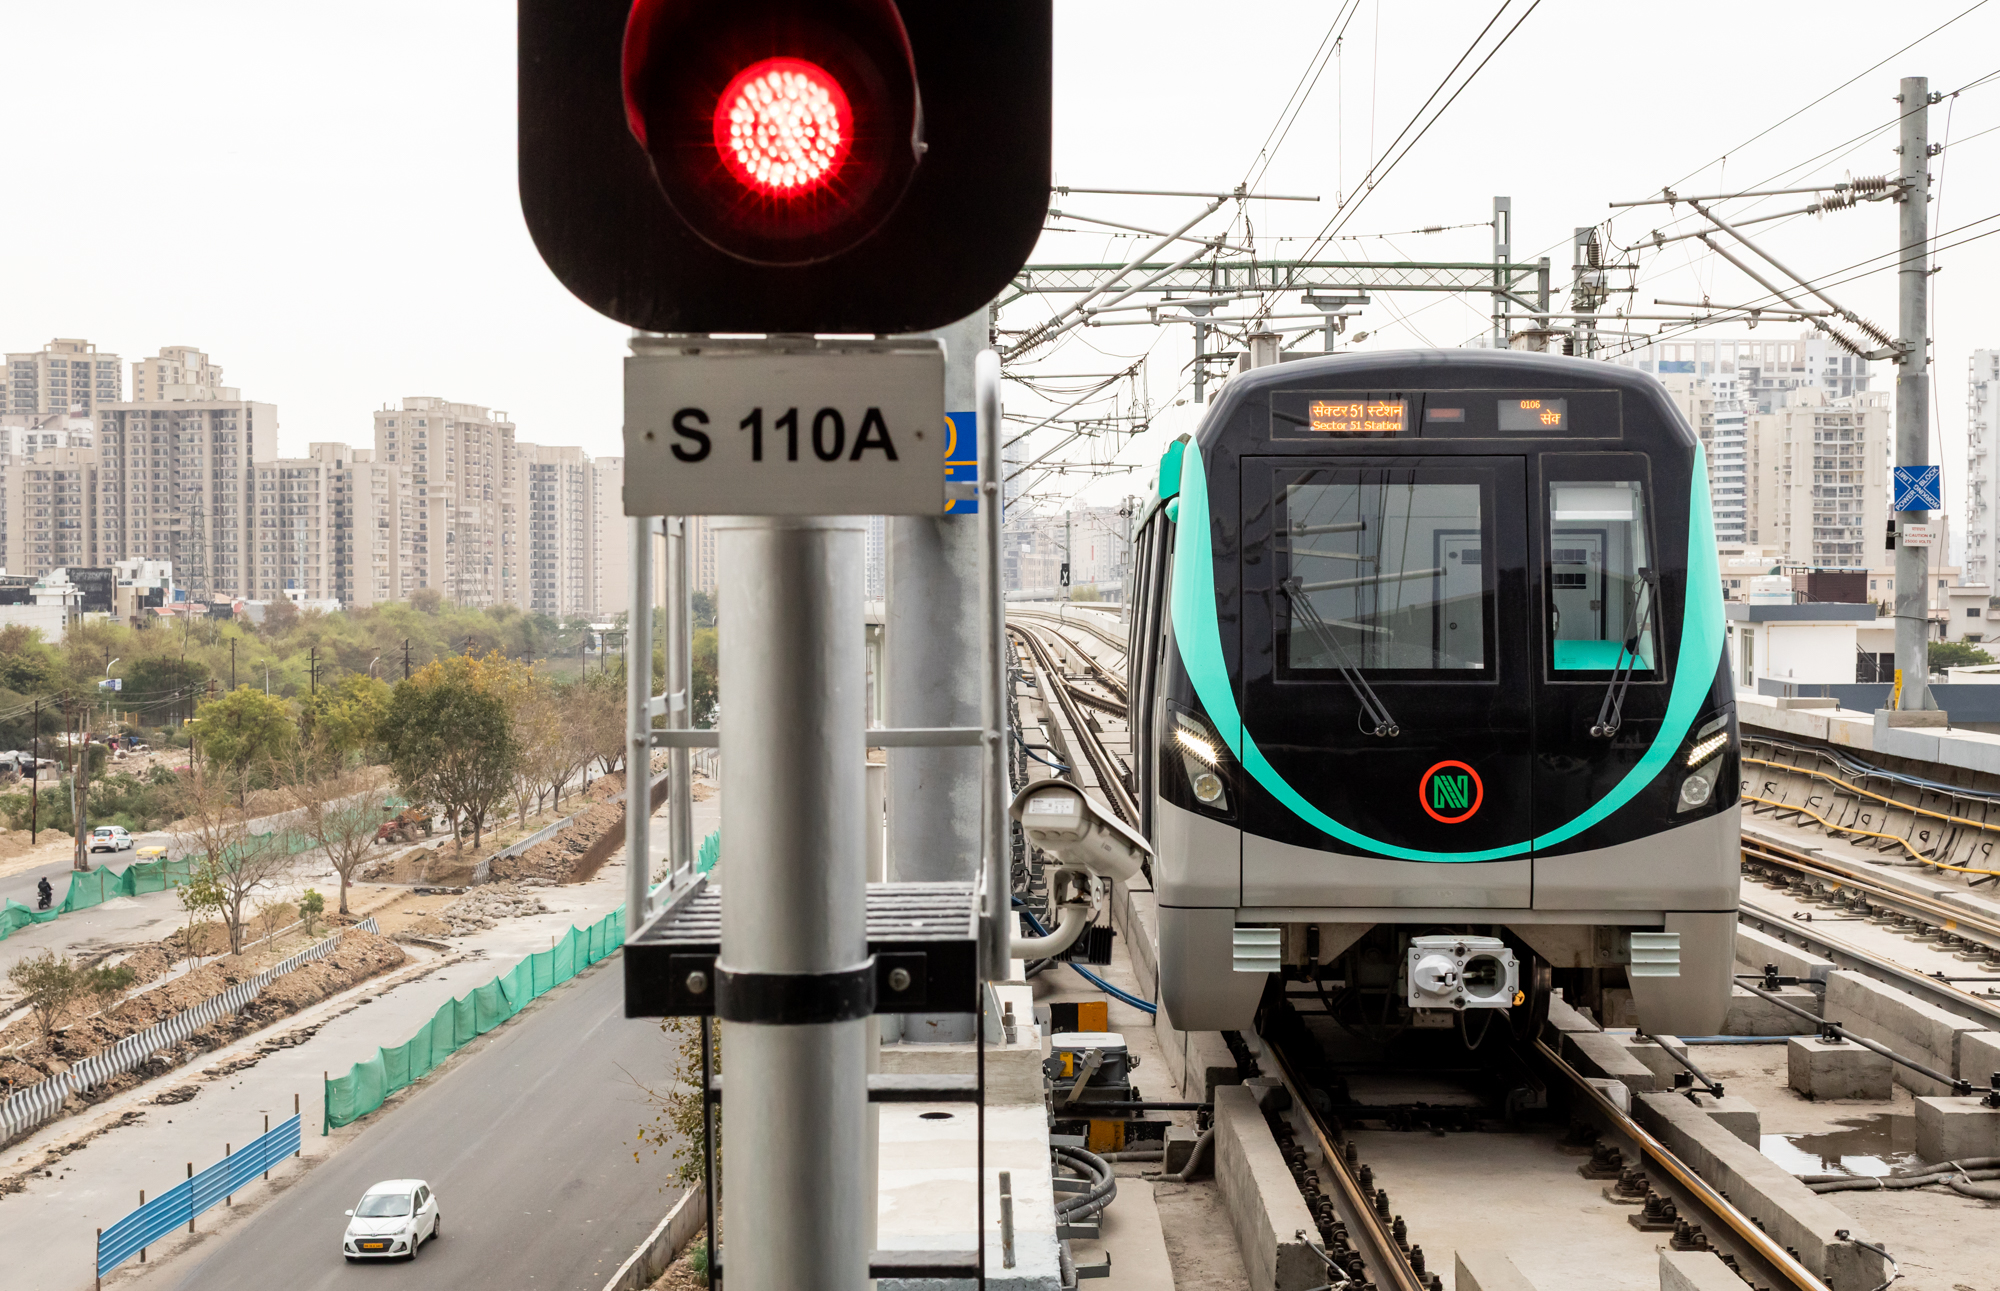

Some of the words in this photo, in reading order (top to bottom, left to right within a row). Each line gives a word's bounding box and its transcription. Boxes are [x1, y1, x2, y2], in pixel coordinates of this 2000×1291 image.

[1312, 401, 1348, 417] सेक्टर
[1350, 404, 1364, 417] 51
[1367, 401, 1404, 417] स्टेशन
[1520, 400, 1541, 410] 0106
[1313, 421, 1348, 430] Sector
[1350, 421, 1362, 430] 51
[1364, 421, 1402, 430] Station
[670, 407, 712, 463] S
[739, 406, 899, 462] 110A
[1895, 469, 1913, 485] LIMIT
[1895, 489, 1916, 511] POWER
[1918, 467, 1939, 486] BLOCK
[1912, 483, 1940, 510] WORKING
